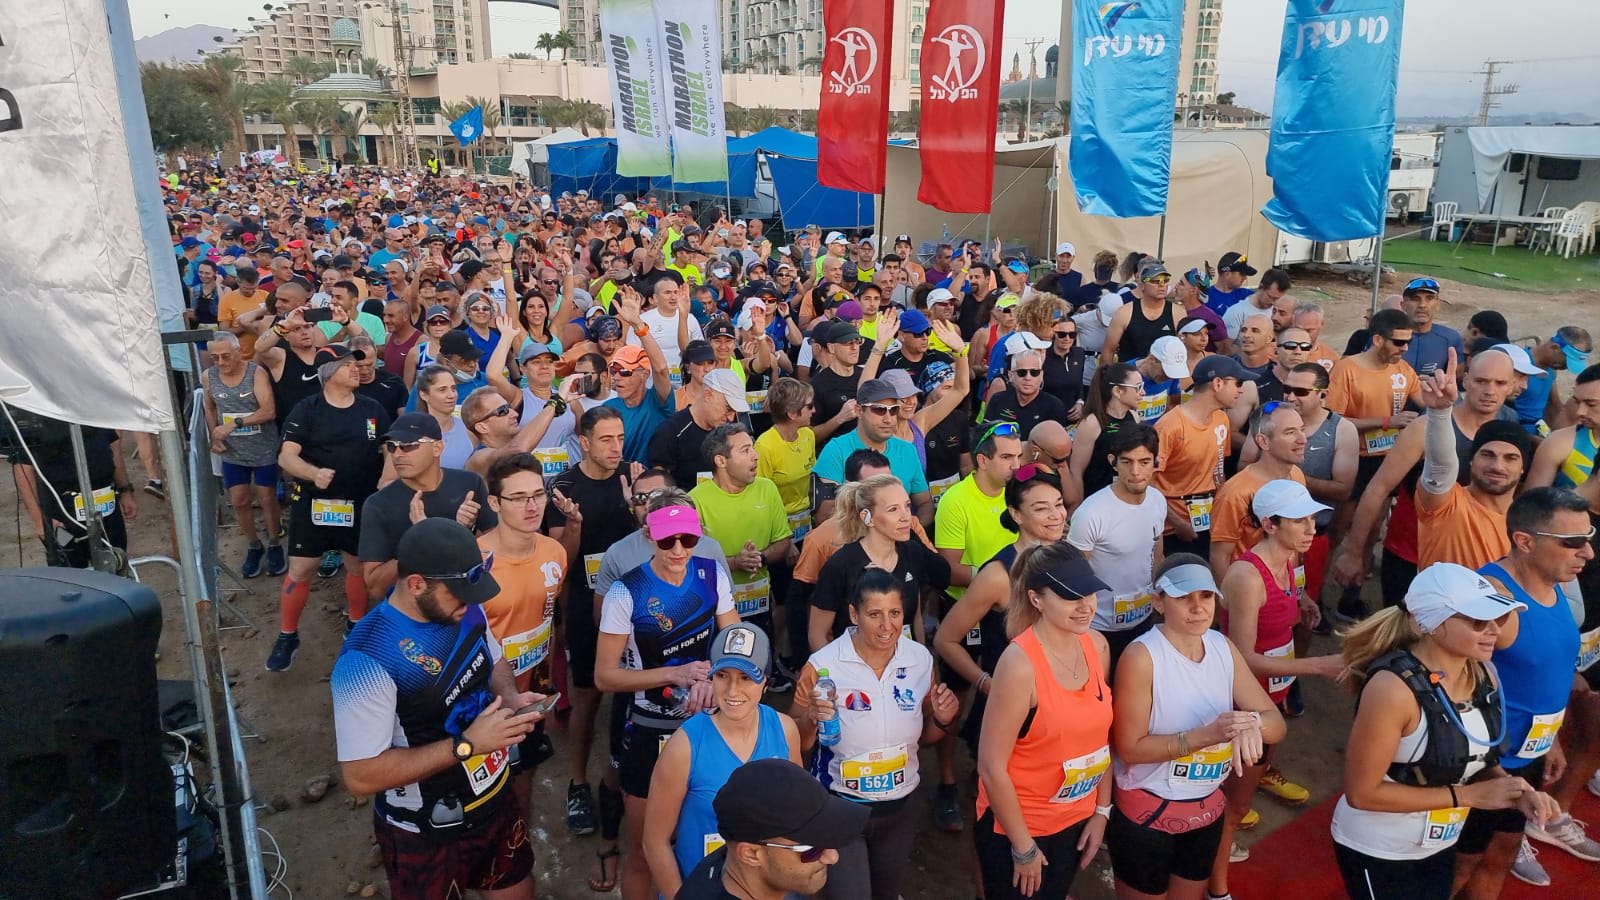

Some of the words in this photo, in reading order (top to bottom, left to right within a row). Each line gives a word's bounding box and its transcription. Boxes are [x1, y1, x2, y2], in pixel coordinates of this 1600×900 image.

[1295, 19, 1351, 60] עדן
[1359, 15, 1389, 44] מי
[702, 24, 713, 90] everywhere
[1084, 34, 1132, 67] עדן
[1138, 33, 1166, 57] מי
[646, 37, 657, 95] everywhere
[664, 19, 691, 132] MARATHON
[609, 33, 637, 134] MARATHON
[632, 78, 654, 138] ISRAEL
[652, 102, 660, 118] run
[686, 71, 709, 137] ISRAEL
[708, 97, 716, 115] run
[654, 124, 661, 138] we
[710, 122, 716, 137] we
[1390, 373, 1407, 389] 10
[663, 645, 679, 656] RUN
[680, 637, 695, 649] FOR
[696, 628, 709, 641] FUN
[445, 685, 461, 706] RUN
[460, 669, 474, 688] FOR
[472, 652, 485, 671] FUN
[858, 766, 872, 776] 10
[865, 774, 889, 789] 562
[1194, 763, 1216, 777] 871
